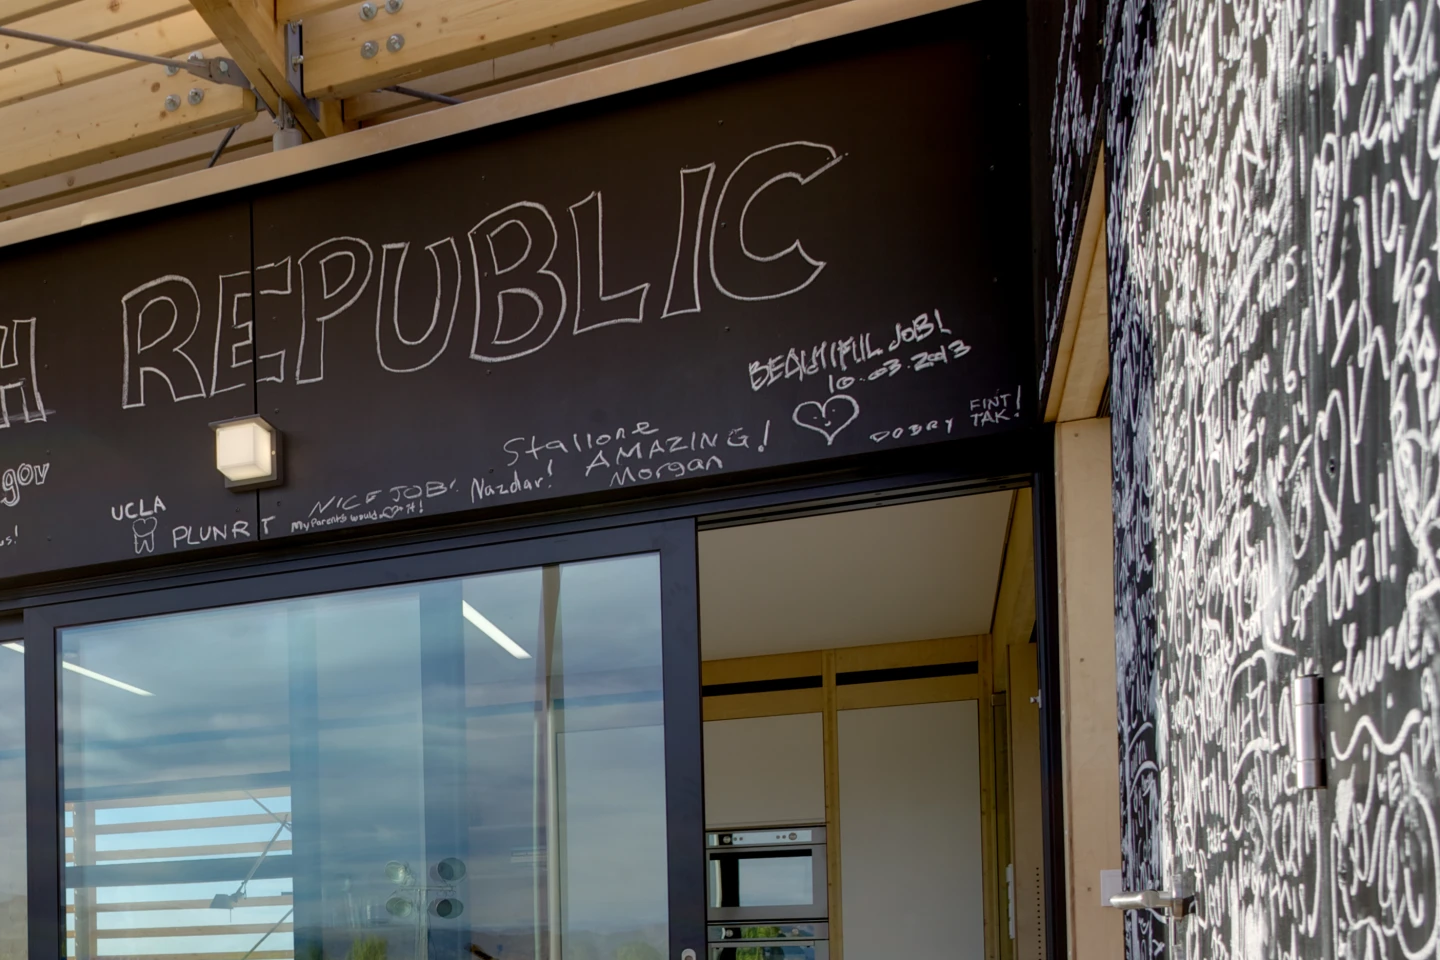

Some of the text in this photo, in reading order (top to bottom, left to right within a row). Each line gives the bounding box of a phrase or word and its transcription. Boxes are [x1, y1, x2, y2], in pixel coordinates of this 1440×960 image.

[122, 140, 845, 408] REPUBLIC
[749, 333, 883, 391] BEAUTIFUL
[504, 421, 659, 467] Stallone
[610, 456, 723, 487] Morgan
[111, 495, 166, 521] UCLA
[309, 490, 382, 518] NICE
